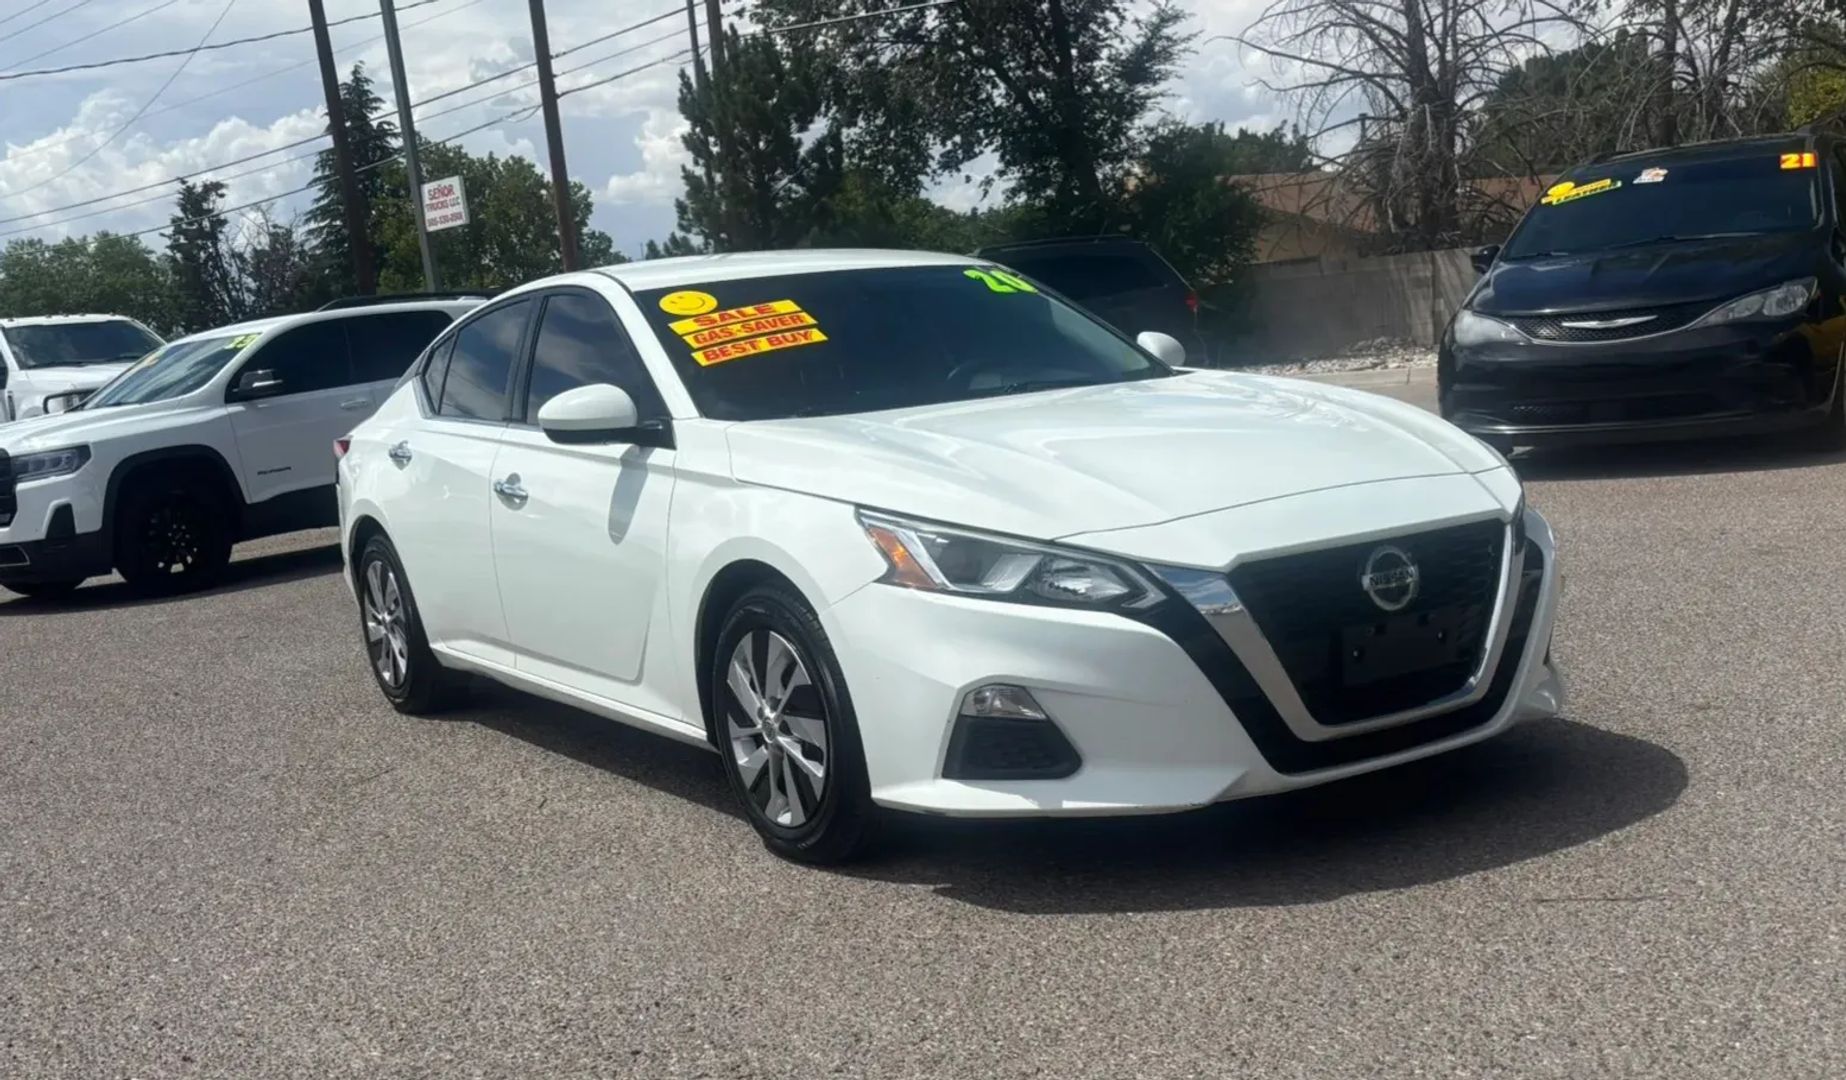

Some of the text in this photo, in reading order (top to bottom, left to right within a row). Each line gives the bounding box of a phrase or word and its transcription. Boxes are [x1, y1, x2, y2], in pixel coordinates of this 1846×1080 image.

[1780, 153, 1815, 169] 21
[962, 268, 1038, 293] 20
[692, 304, 777, 327] SALE
[703, 330, 812, 363] BEST BUY
